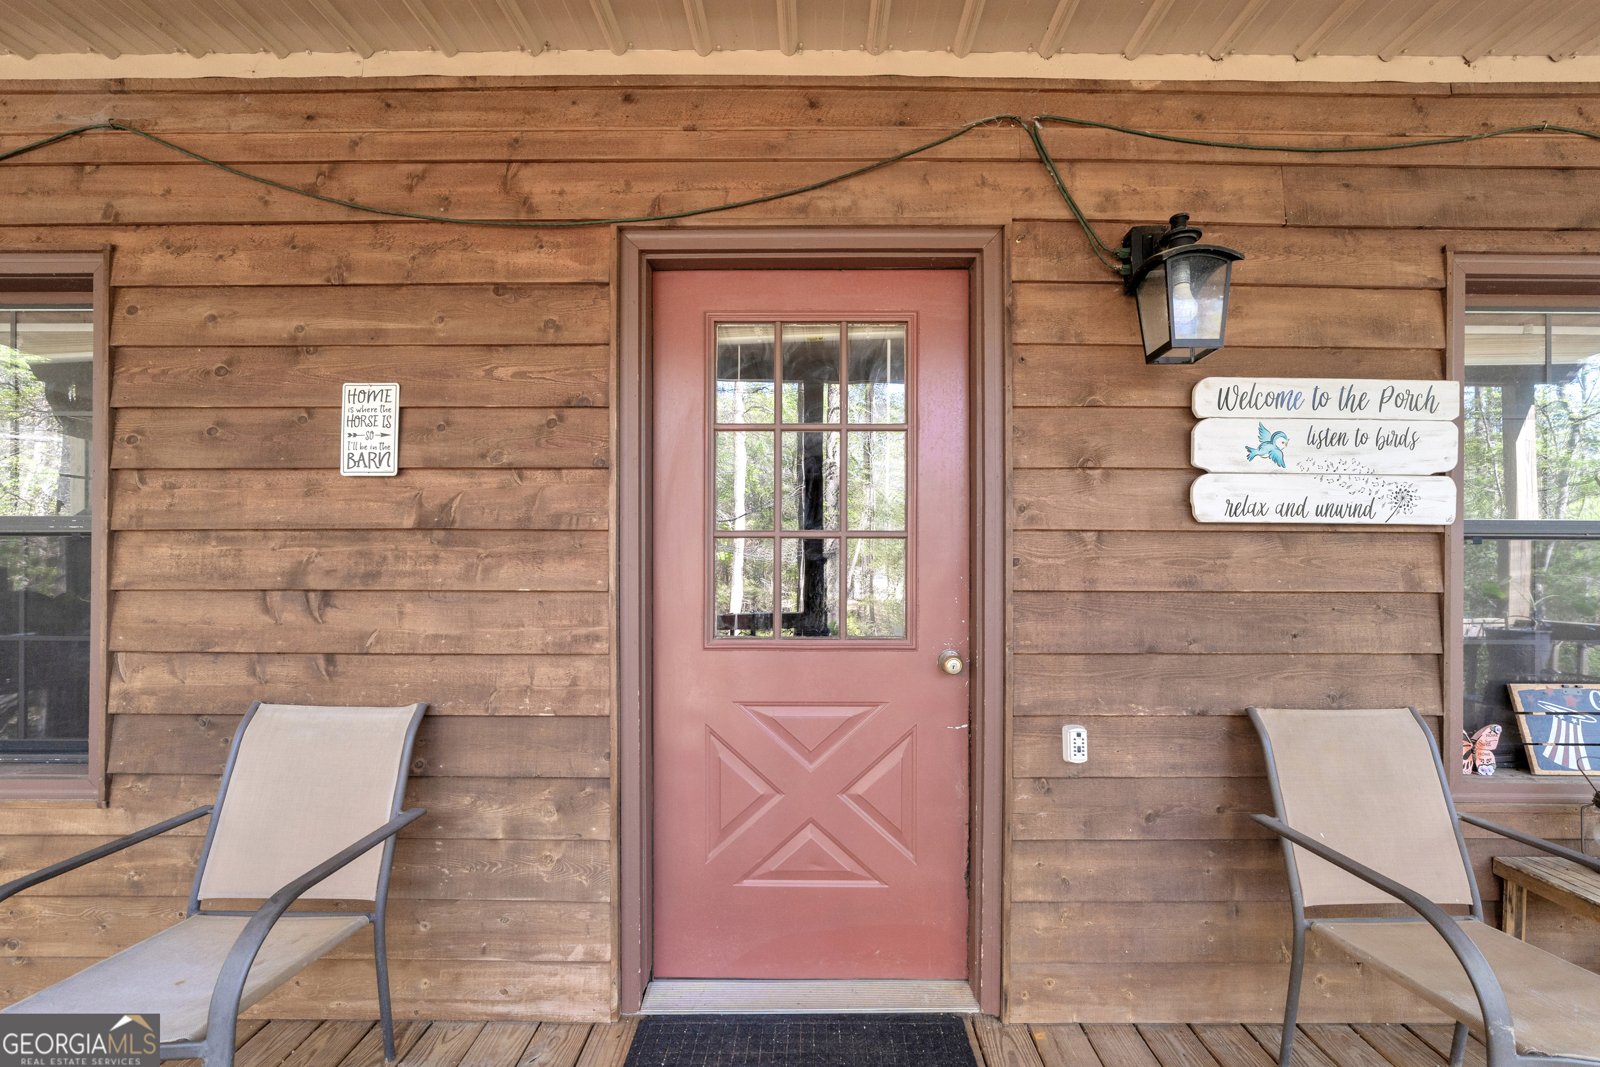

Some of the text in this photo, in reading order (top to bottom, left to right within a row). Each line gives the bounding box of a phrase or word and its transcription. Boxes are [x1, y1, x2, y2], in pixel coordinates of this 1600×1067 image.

[347, 388, 392, 404] HOME
[1217, 382, 1440, 414] Welcome to the Porch
[356, 404, 377, 413] where
[380, 404, 391, 413] the
[346, 414, 392, 428] HORSE IS
[359, 441, 368, 451] be
[379, 441, 391, 451] the
[1306, 425, 1420, 450] listen to birds
[347, 451, 391, 470] BARN
[1223, 495, 1377, 519] relax and unwind
